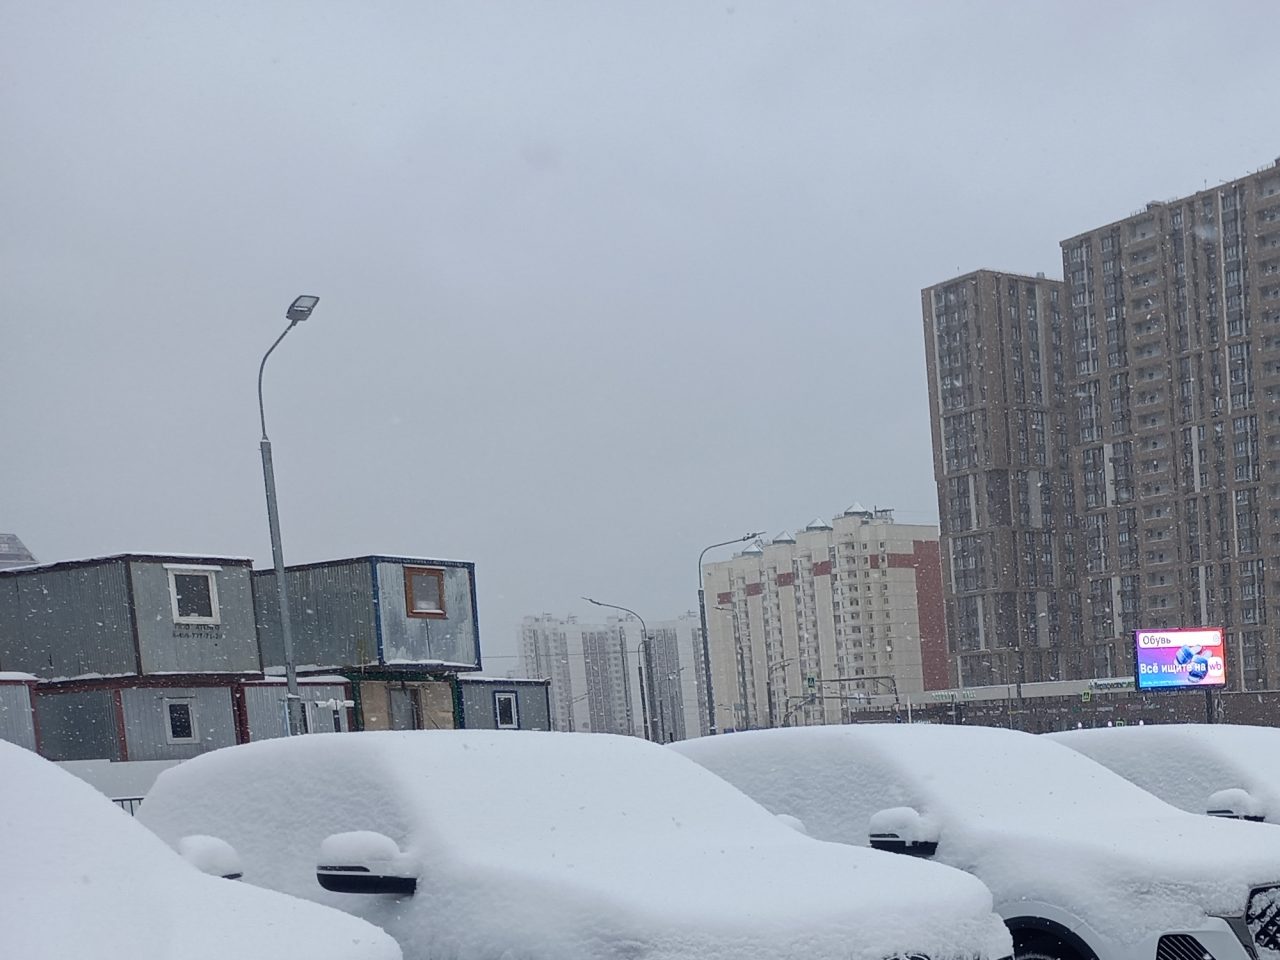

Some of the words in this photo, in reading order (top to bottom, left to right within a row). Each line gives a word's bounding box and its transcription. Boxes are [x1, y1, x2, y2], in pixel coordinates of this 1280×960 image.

[1142, 635, 1171, 646] Обувь
[1140, 662, 1159, 674] Всё
[1161, 664, 1193, 674] ищите
[1194, 663, 1206, 672] на
[1209, 661, 1222, 671] wb
